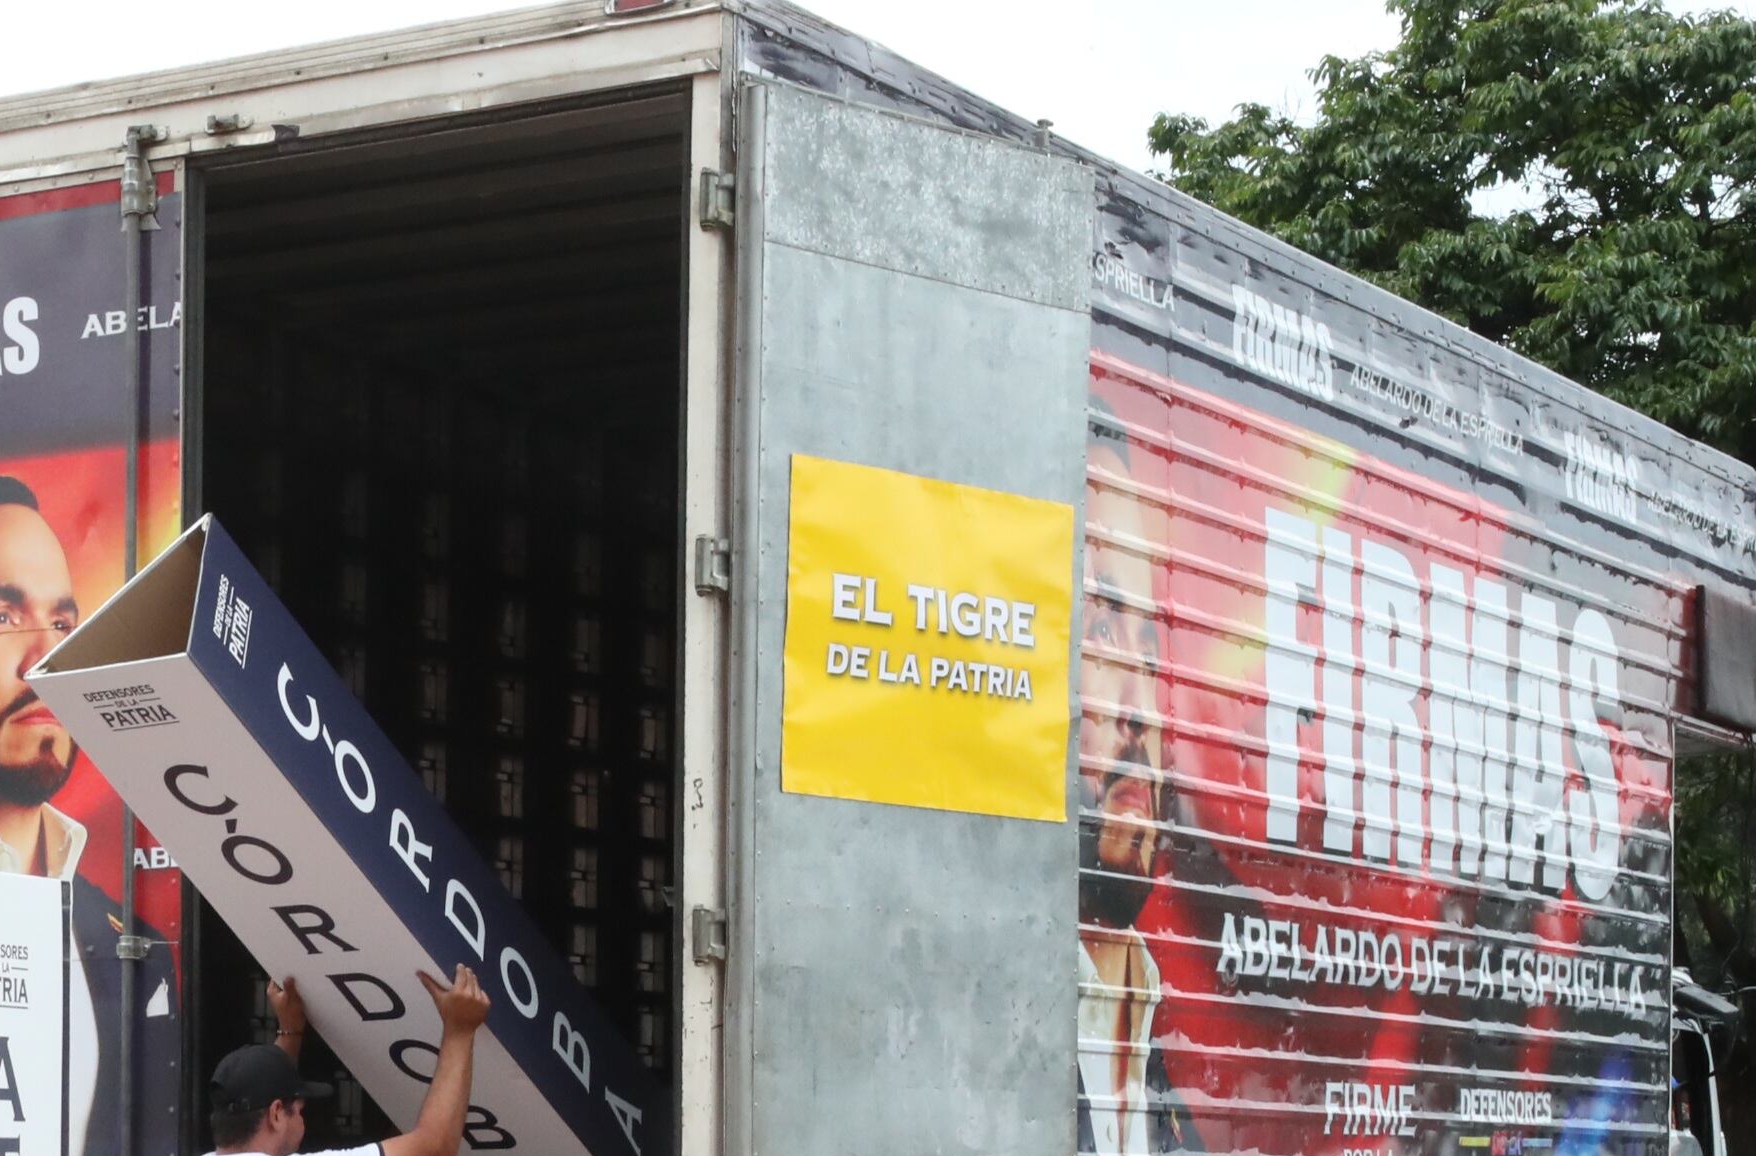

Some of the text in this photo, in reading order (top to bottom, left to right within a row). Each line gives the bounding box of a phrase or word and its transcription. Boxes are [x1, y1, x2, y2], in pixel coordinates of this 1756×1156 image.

[1092, 252, 1175, 311] SPRIELLA
[1232, 283, 1334, 401] FIRMAS
[1350, 364, 1524, 456] ABELARDO DE LA ESPRIELLA
[1564, 431, 1637, 525] FIRMAS
[213, 574, 229, 639] DEFENSORES
[229, 597, 250, 665] PATRIA
[832, 572, 1035, 647] EL TIGRE
[83, 684, 155, 702] DEFENSORES
[827, 644, 1032, 700] DE LA PATRIA
[1265, 506, 1619, 900] FIRMAS
[100, 704, 177, 728] PATRIA
[115, 700, 128, 708] DE
[2, 962, 10, 973] LA
[1217, 913, 1404, 990] ABELARDO
[1411, 938, 1450, 997] DE
[1458, 943, 1495, 999] LA
[1323, 1082, 1416, 1137] FIRME
[1460, 1088, 1552, 1124] DEFENSORES
